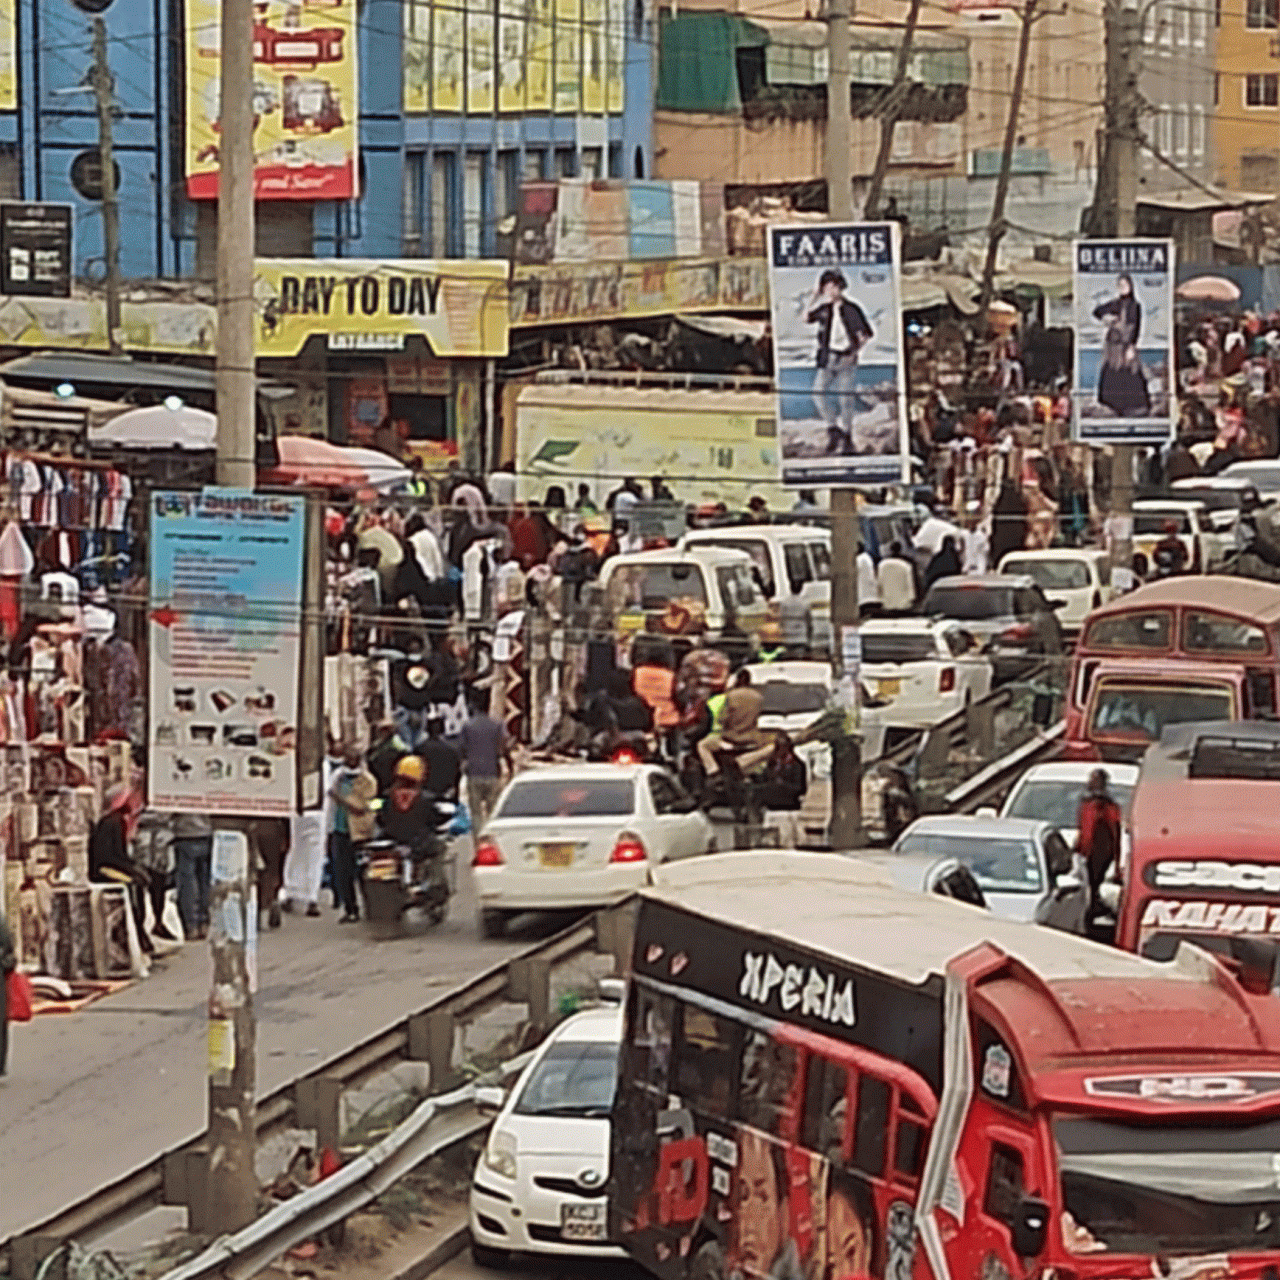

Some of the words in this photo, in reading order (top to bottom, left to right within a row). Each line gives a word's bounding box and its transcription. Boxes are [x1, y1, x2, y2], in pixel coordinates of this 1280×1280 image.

[779, 230, 886, 256] FAARIS
[281, 275, 335, 316] DAY
[344, 275, 380, 316] TO
[388, 275, 443, 316] DAY
[740, 951, 855, 1027] XPERIA
